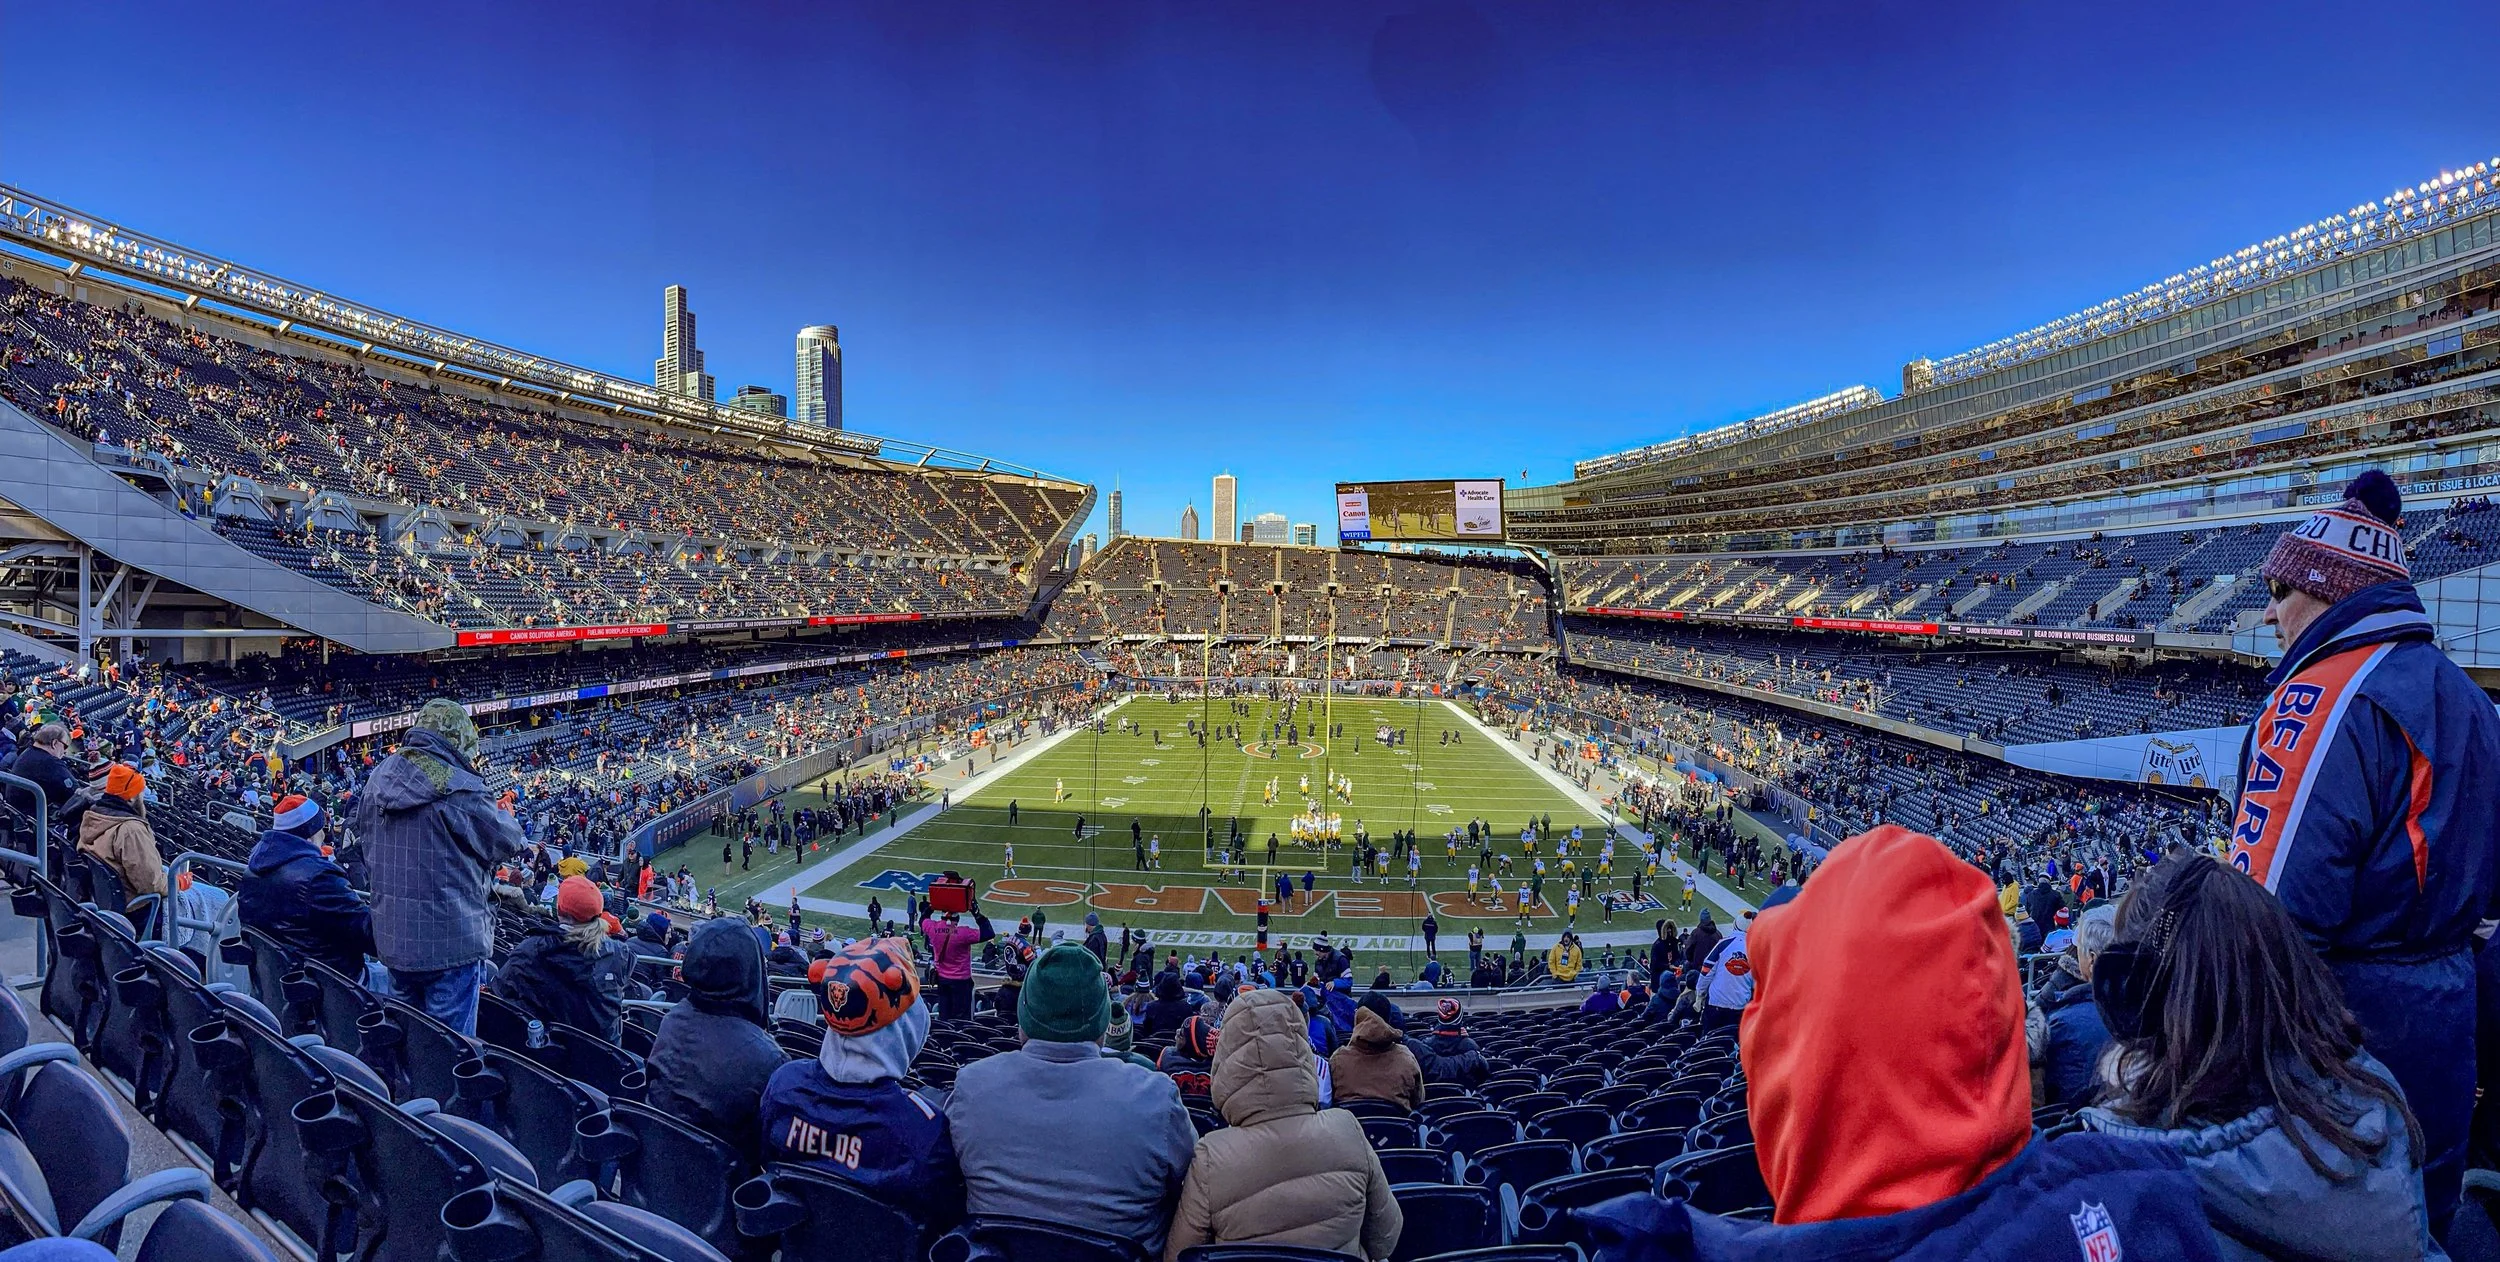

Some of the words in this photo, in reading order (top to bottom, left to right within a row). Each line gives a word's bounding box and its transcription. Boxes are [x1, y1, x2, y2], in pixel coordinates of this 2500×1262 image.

[2414, 482, 2437, 493] TEXT
[2438, 480, 2464, 491] ISSUE
[2465, 479, 2473, 489] &
[2304, 495, 2320, 505] FOR
[2321, 492, 2346, 504] SECU
[1342, 510, 1366, 518] Canon
[475, 632, 494, 640] Canon
[509, 631, 528, 641] CANON
[528, 630, 556, 640] SOLUTIONS
[556, 629, 577, 638] AMERICA
[587, 628, 605, 636] FUELING
[605, 627, 629, 635] WORKPLACE
[629, 626, 652, 634] EFFICIENCY
[1966, 627, 1980, 635] CANON
[1981, 628, 2003, 636] SOLUTIONS
[2003, 629, 2023, 637] AMERICA
[2034, 630, 2048, 638] BEAR
[2048, 631, 2063, 639] DOWN
[2072, 632, 2087, 641] YOUR
[2087, 633, 2115, 642] BUSINESS
[2115, 634, 2135, 643] GOALS
[639, 676, 680, 690] PACKERS
[475, 702, 508, 715] VERSUS
[124, 733, 135, 747] 34
[2149, 750, 2172, 769] Lite
[2178, 752, 2201, 775] Lite
[2230, 682, 2327, 875] BEARS
[934, 927, 958, 935] VENDR
[1217, 934, 1257, 946] MY
[1363, 937, 1407, 949] MY
[1110, 1025, 1126, 1035] BAY
[785, 1115, 863, 1171] FIELDS
